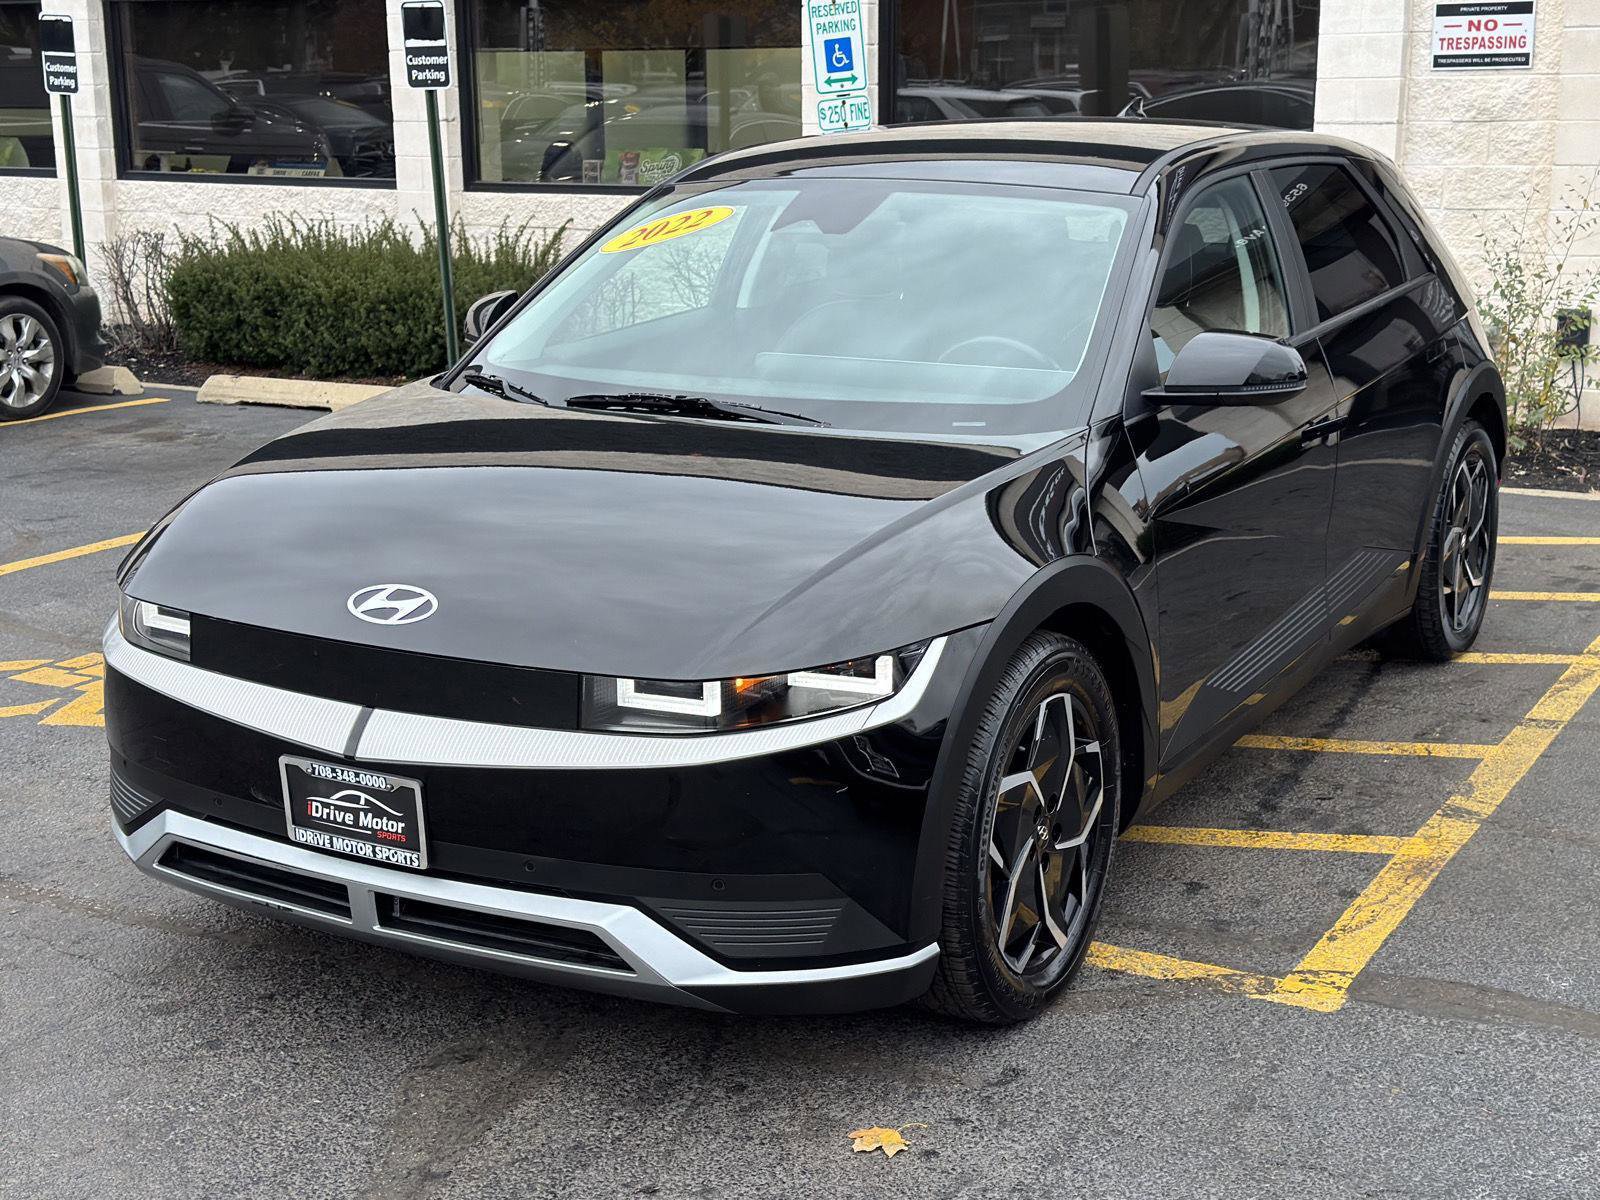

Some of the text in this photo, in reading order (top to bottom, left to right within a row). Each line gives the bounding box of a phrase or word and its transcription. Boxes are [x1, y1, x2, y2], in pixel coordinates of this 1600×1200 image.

[811, 1, 857, 18] RESERVED
[816, 18, 856, 35] PARKING
[1467, 19, 1498, 32] NO
[1439, 35, 1527, 50] TRESPASSING
[45, 62, 77, 73] Customer
[406, 55, 448, 65] Customer
[49, 76, 76, 89] Parking
[411, 69, 446, 82] Parking
[820, 102, 870, 124] $250 FINE
[640, 158, 677, 175] Spring
[618, 209, 714, 249] 2022
[312, 764, 386, 789] 708-348-0000
[307, 801, 405, 833] iDrive Motor
[376, 831, 406, 842] SPORTS
[332, 837, 374, 857] MOTOR
[375, 847, 419, 867] SPORTS
